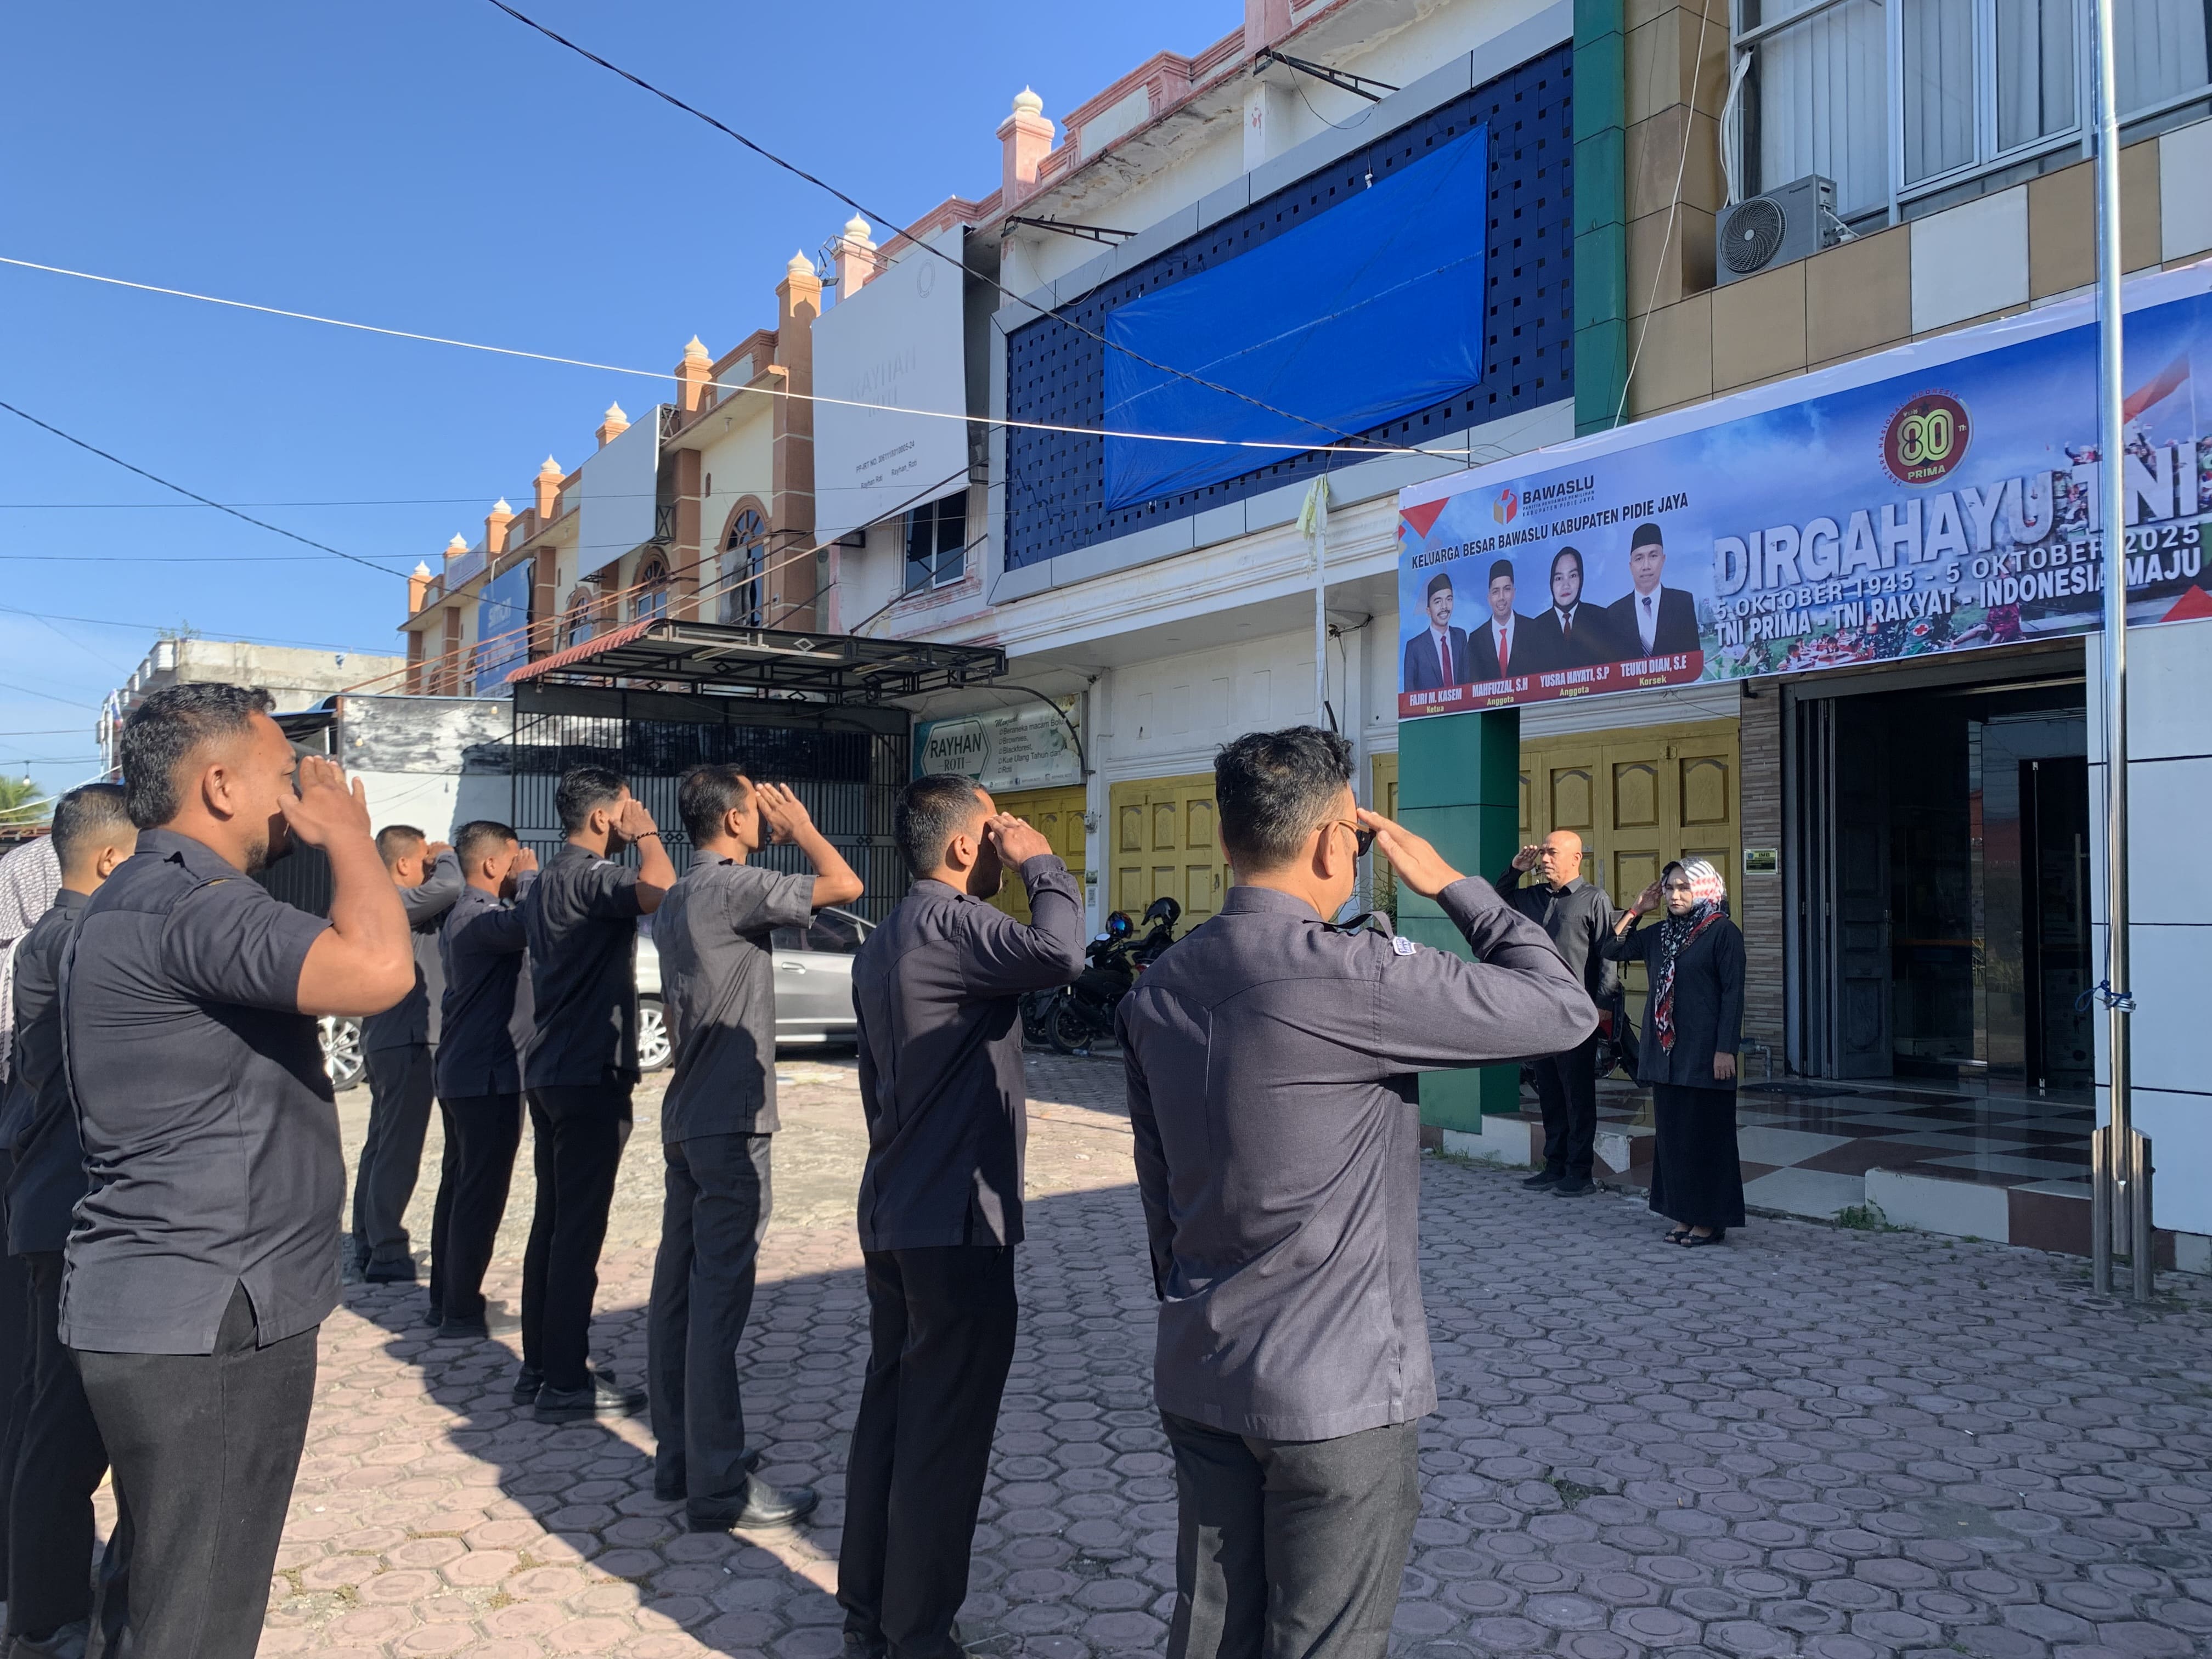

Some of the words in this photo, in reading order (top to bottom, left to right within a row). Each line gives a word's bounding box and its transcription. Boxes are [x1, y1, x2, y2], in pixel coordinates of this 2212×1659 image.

[1908, 387, 1959, 402] INDONESIA
[1897, 408, 1954, 466] 80
[1908, 465, 1946, 480] PRIMA
[1523, 475, 1594, 505] BAWASLU
[1579, 495, 1594, 504] JAYA
[1714, 470, 2055, 597] DIRGAHAYU
[2072, 442, 2198, 532] TNI
[1412, 546, 1460, 569] KELUARGA
[1463, 537, 1496, 557] BESAR
[1498, 524, 1548, 549] BAWASLU
[1552, 508, 1618, 537] KABUPATEN
[1623, 500, 1654, 521] PIDIE
[1658, 492, 1688, 513] JAYA
[1714, 601, 1728, 620] 5
[1736, 582, 1843, 617] OKTOBER
[1856, 570, 1914, 597] 1945
[1946, 562, 1960, 583] 5
[1972, 538, 2104, 578] OKTOBER
[2126, 521, 2199, 554] 2025
[1715, 620, 1744, 646] TNI
[1750, 610, 1812, 641] PRIMA
[1832, 601, 1864, 629] TNI
[1871, 586, 1956, 624] RAKYAT
[2126, 547, 2200, 586] MAJU
[1620, 661, 1647, 677] TEUKU
[1649, 657, 1672, 673] DIAN,
[1673, 655, 1687, 670] S.E
[1540, 672, 1566, 688] YUSRA
[1567, 668, 1595, 685] HAYATI,
[1596, 667, 1610, 680] S.P
[1639, 675, 1667, 686] Korsek
[1409, 692, 1427, 706] FAJRI
[1429, 693, 1437, 704] M.
[1438, 688, 1462, 703] KASEM
[1472, 680, 1514, 698] MAHFUZZAL,
[1515, 677, 1528, 692] S.H
[1560, 686, 1589, 697] Anggota
[1426, 705, 1444, 713] Ketua
[1487, 696, 1514, 706] Anggota
[1029, 721, 1049, 730] macam
[930, 732, 981, 759] RAYHAN
[1031, 751, 1048, 760] Tahun
